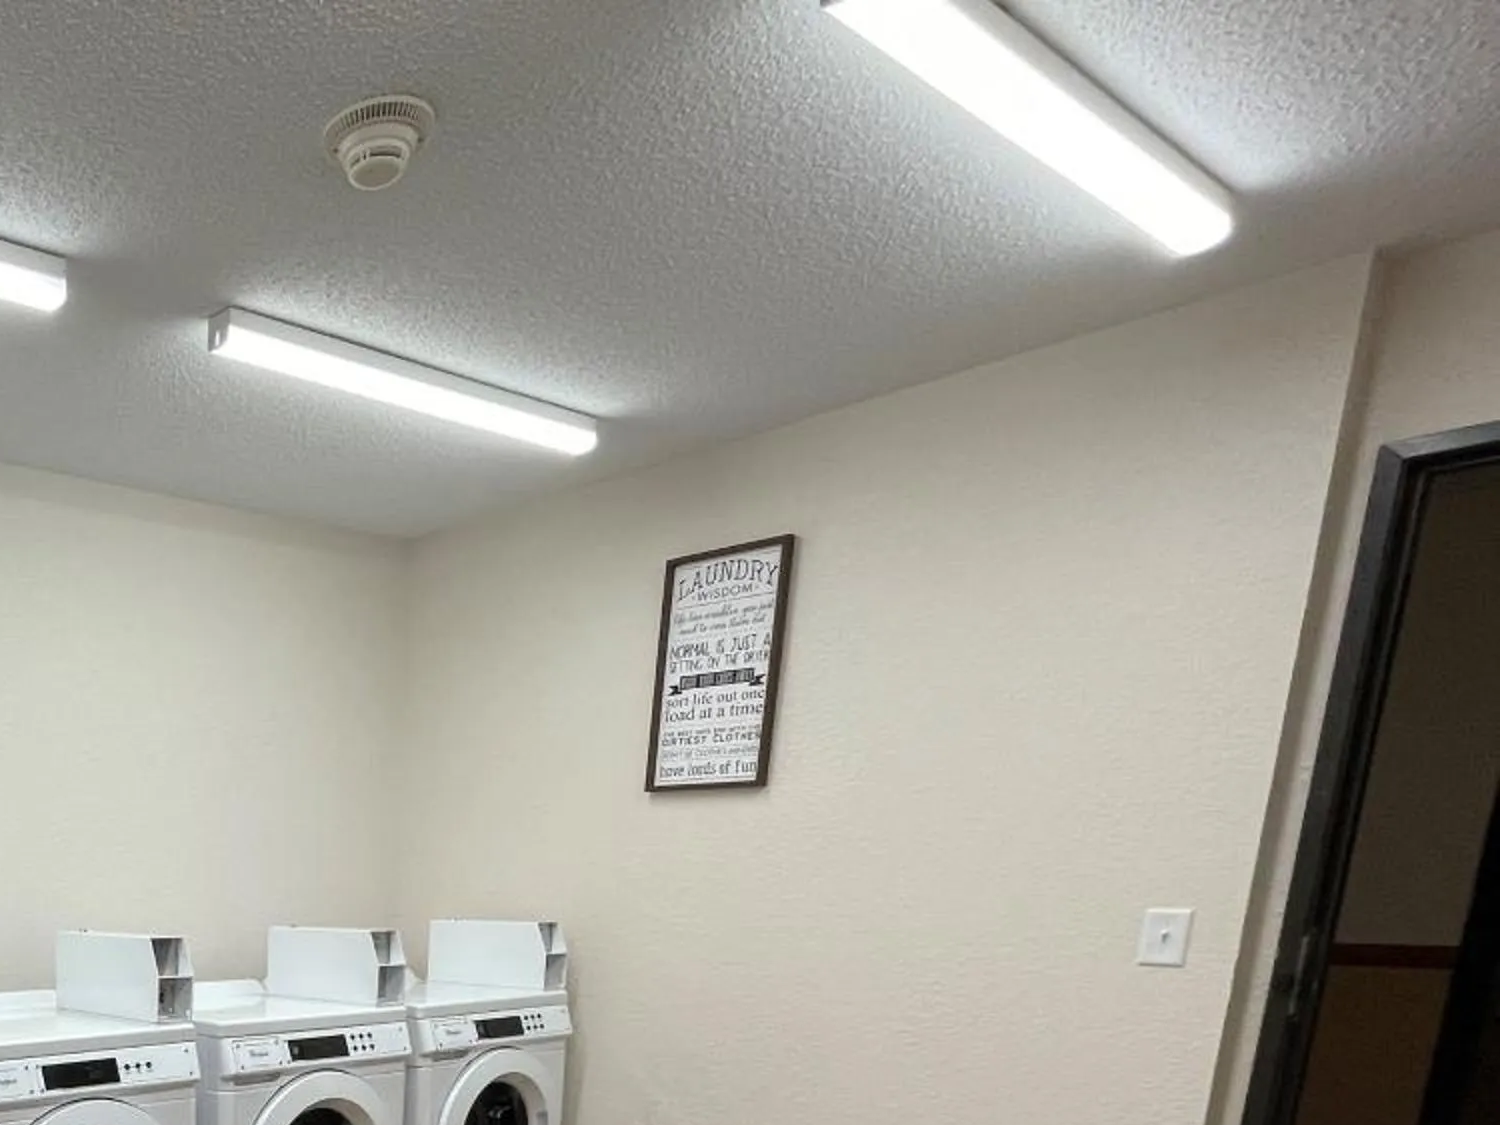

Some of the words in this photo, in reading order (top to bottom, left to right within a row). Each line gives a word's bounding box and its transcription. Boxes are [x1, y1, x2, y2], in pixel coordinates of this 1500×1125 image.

[677, 558, 779, 602] LAUNDRY
[696, 583, 753, 601] WISDOM
[669, 641, 710, 660] NORMAL
[730, 633, 757, 652] JUST
[666, 697, 689, 709] sort
[693, 691, 713, 705] life
[717, 690, 737, 703] out
[741, 689, 765, 701] one
[665, 706, 695, 723] load
[699, 707, 713, 719] at
[716, 706, 726, 718] a
[729, 703, 764, 717] time
[735, 759, 758, 774] fun
